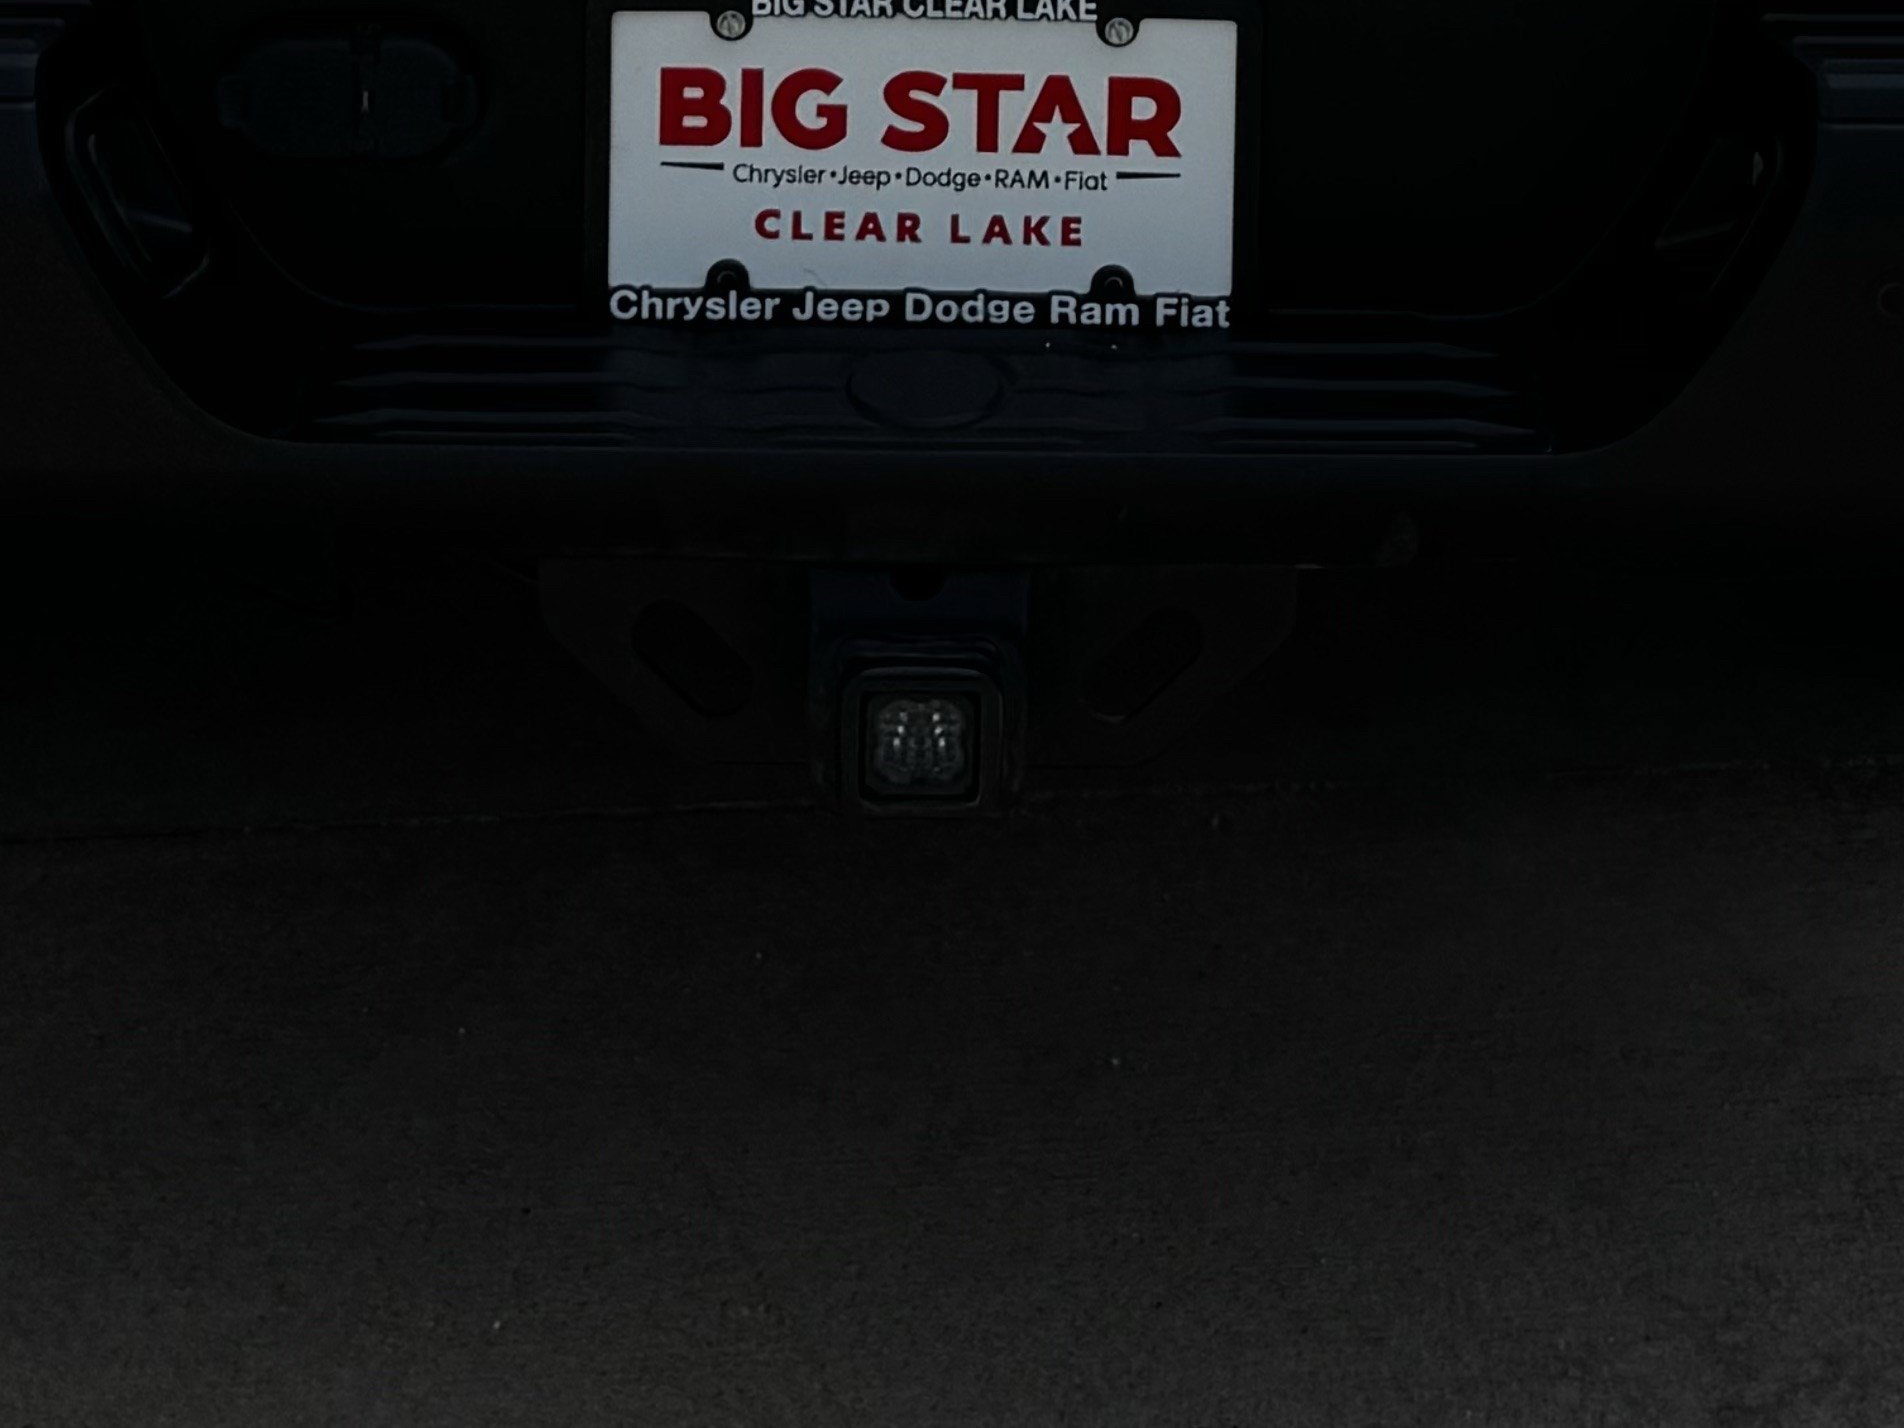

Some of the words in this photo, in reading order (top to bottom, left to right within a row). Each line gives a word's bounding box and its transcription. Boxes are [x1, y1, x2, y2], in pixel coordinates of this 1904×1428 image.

[658, 66, 849, 151] BIG
[880, 70, 1183, 159] STAR
[732, 162, 826, 189] Chrysler
[837, 164, 892, 190] Jeep
[905, 166, 983, 193] Dodge
[995, 168, 1051, 191] RAM
[1064, 169, 1109, 192] Fiat
[754, 208, 922, 244] CLEAR
[950, 213, 1083, 247] LAKE
[609, 287, 781, 322] Chrysler
[792, 290, 891, 323] Jeep
[904, 292, 1036, 327] Dodge
[1050, 295, 1141, 328] Ram
[1155, 297, 1231, 330] Fiat
